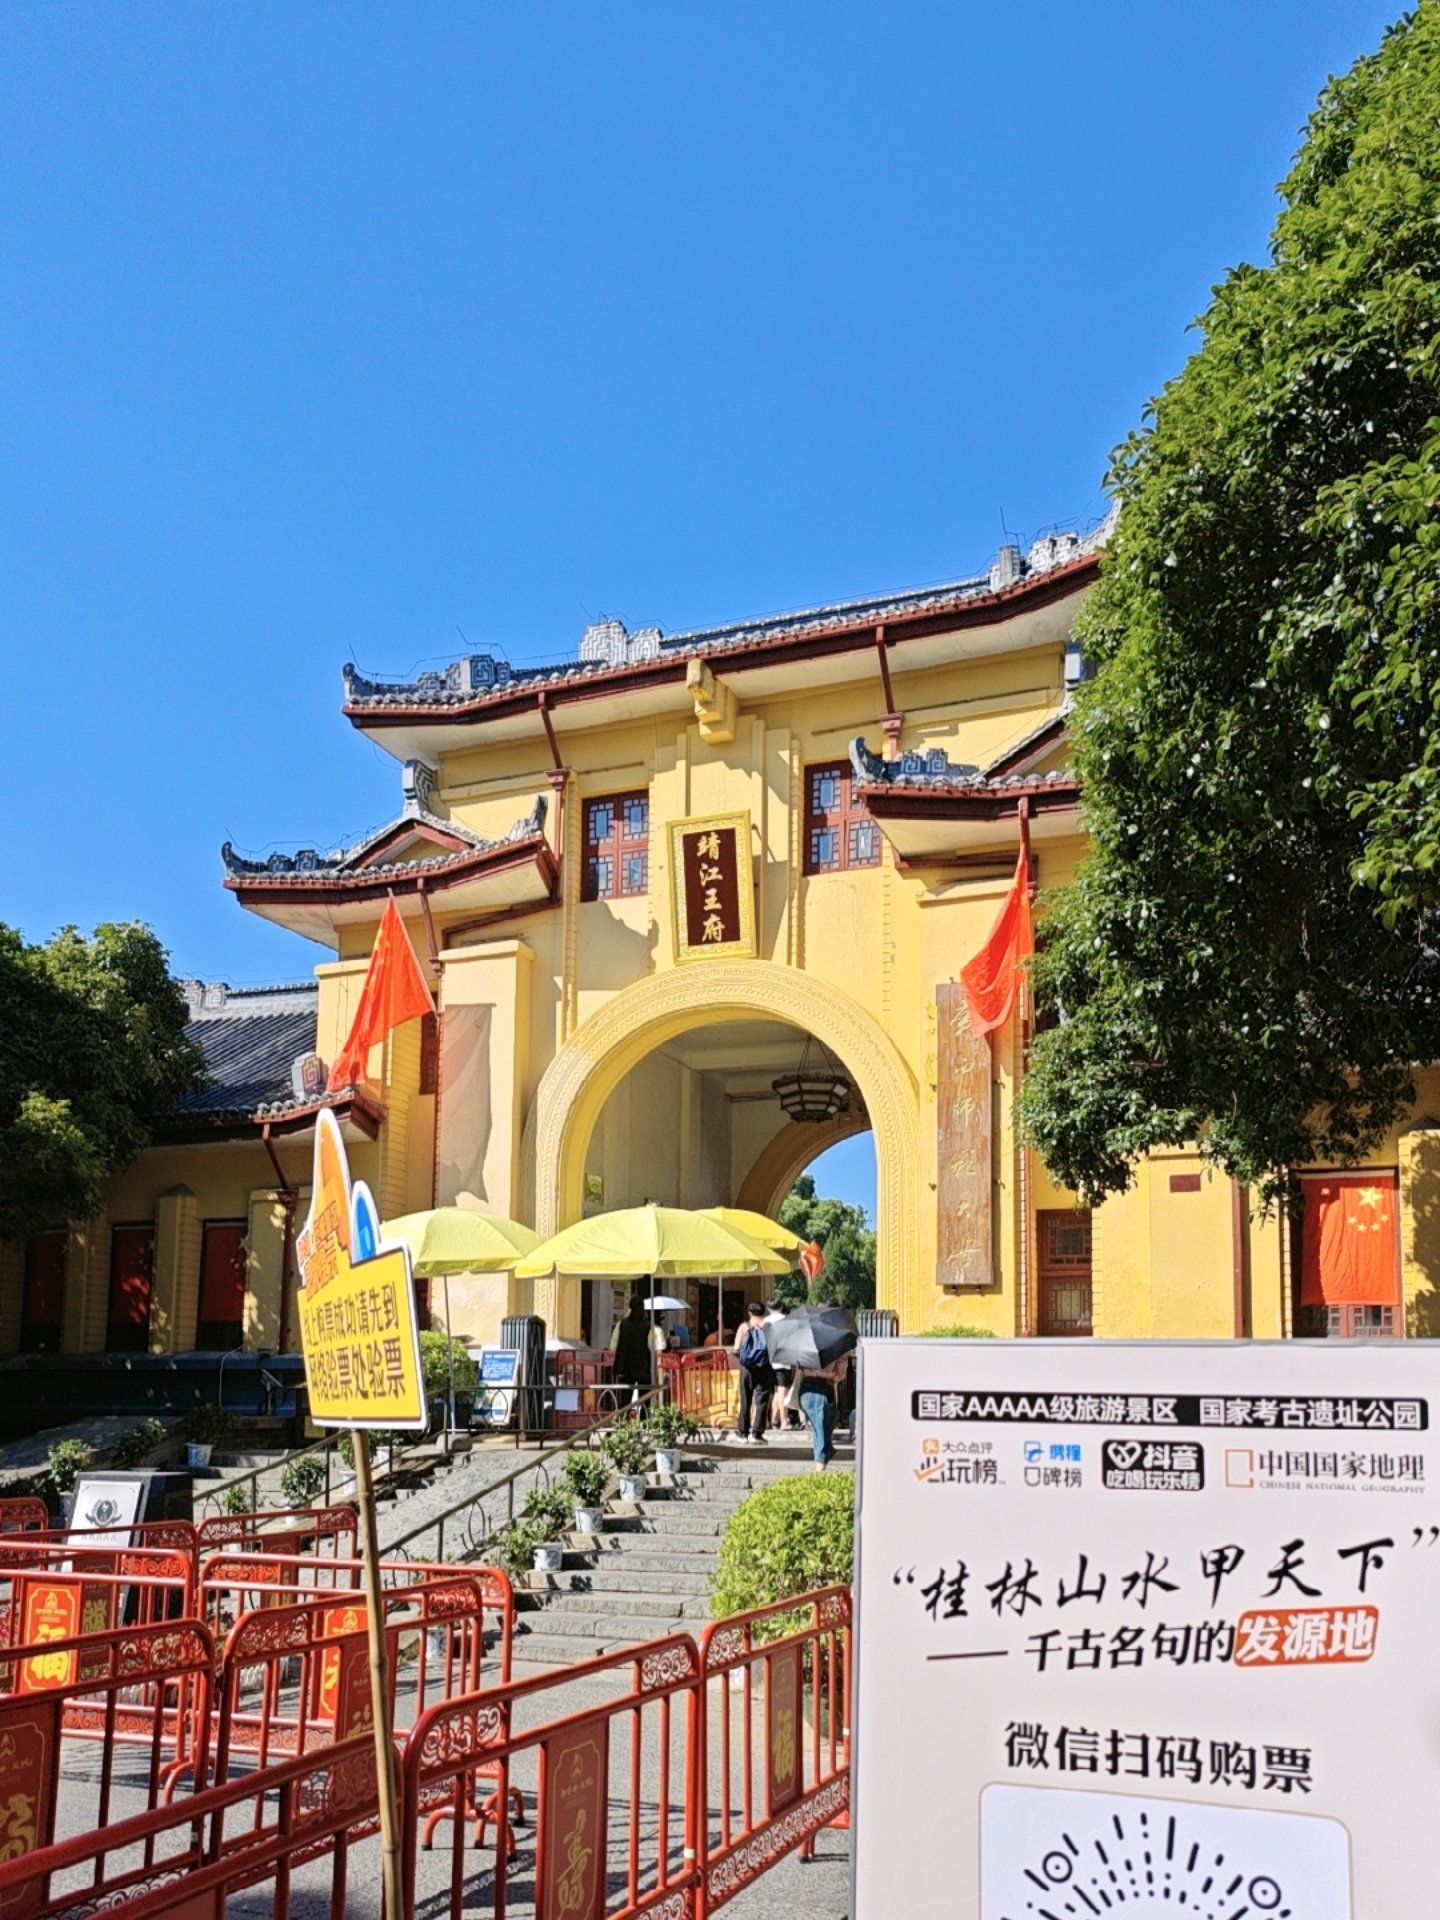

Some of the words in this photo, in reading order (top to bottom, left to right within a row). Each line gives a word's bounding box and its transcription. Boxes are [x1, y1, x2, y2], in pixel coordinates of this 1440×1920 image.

[697, 832, 725, 942] 靖江王府
[917, 1393, 1179, 1425] 国家AAAAA级旅游景区
[1199, 1398, 1423, 1430] 国家考古遗址公园
[942, 1441, 993, 1454] 大众点评
[1049, 1444, 1081, 1461] 携程
[1143, 1445, 1198, 1471] 抖音
[1258, 1449, 1426, 1482] 中国国家地理
[1024, 1467, 1083, 1488] 口碑榜
[1106, 1470, 1200, 1491] 吃喝玩乐榜
[1259, 1481, 1302, 1490] CHINESE
[1305, 1483, 1356, 1491] NATIONAL
[1361, 1484, 1426, 1494] GEOGRAPHY
[1004, 1720, 1313, 1794] 微信扫码购票
